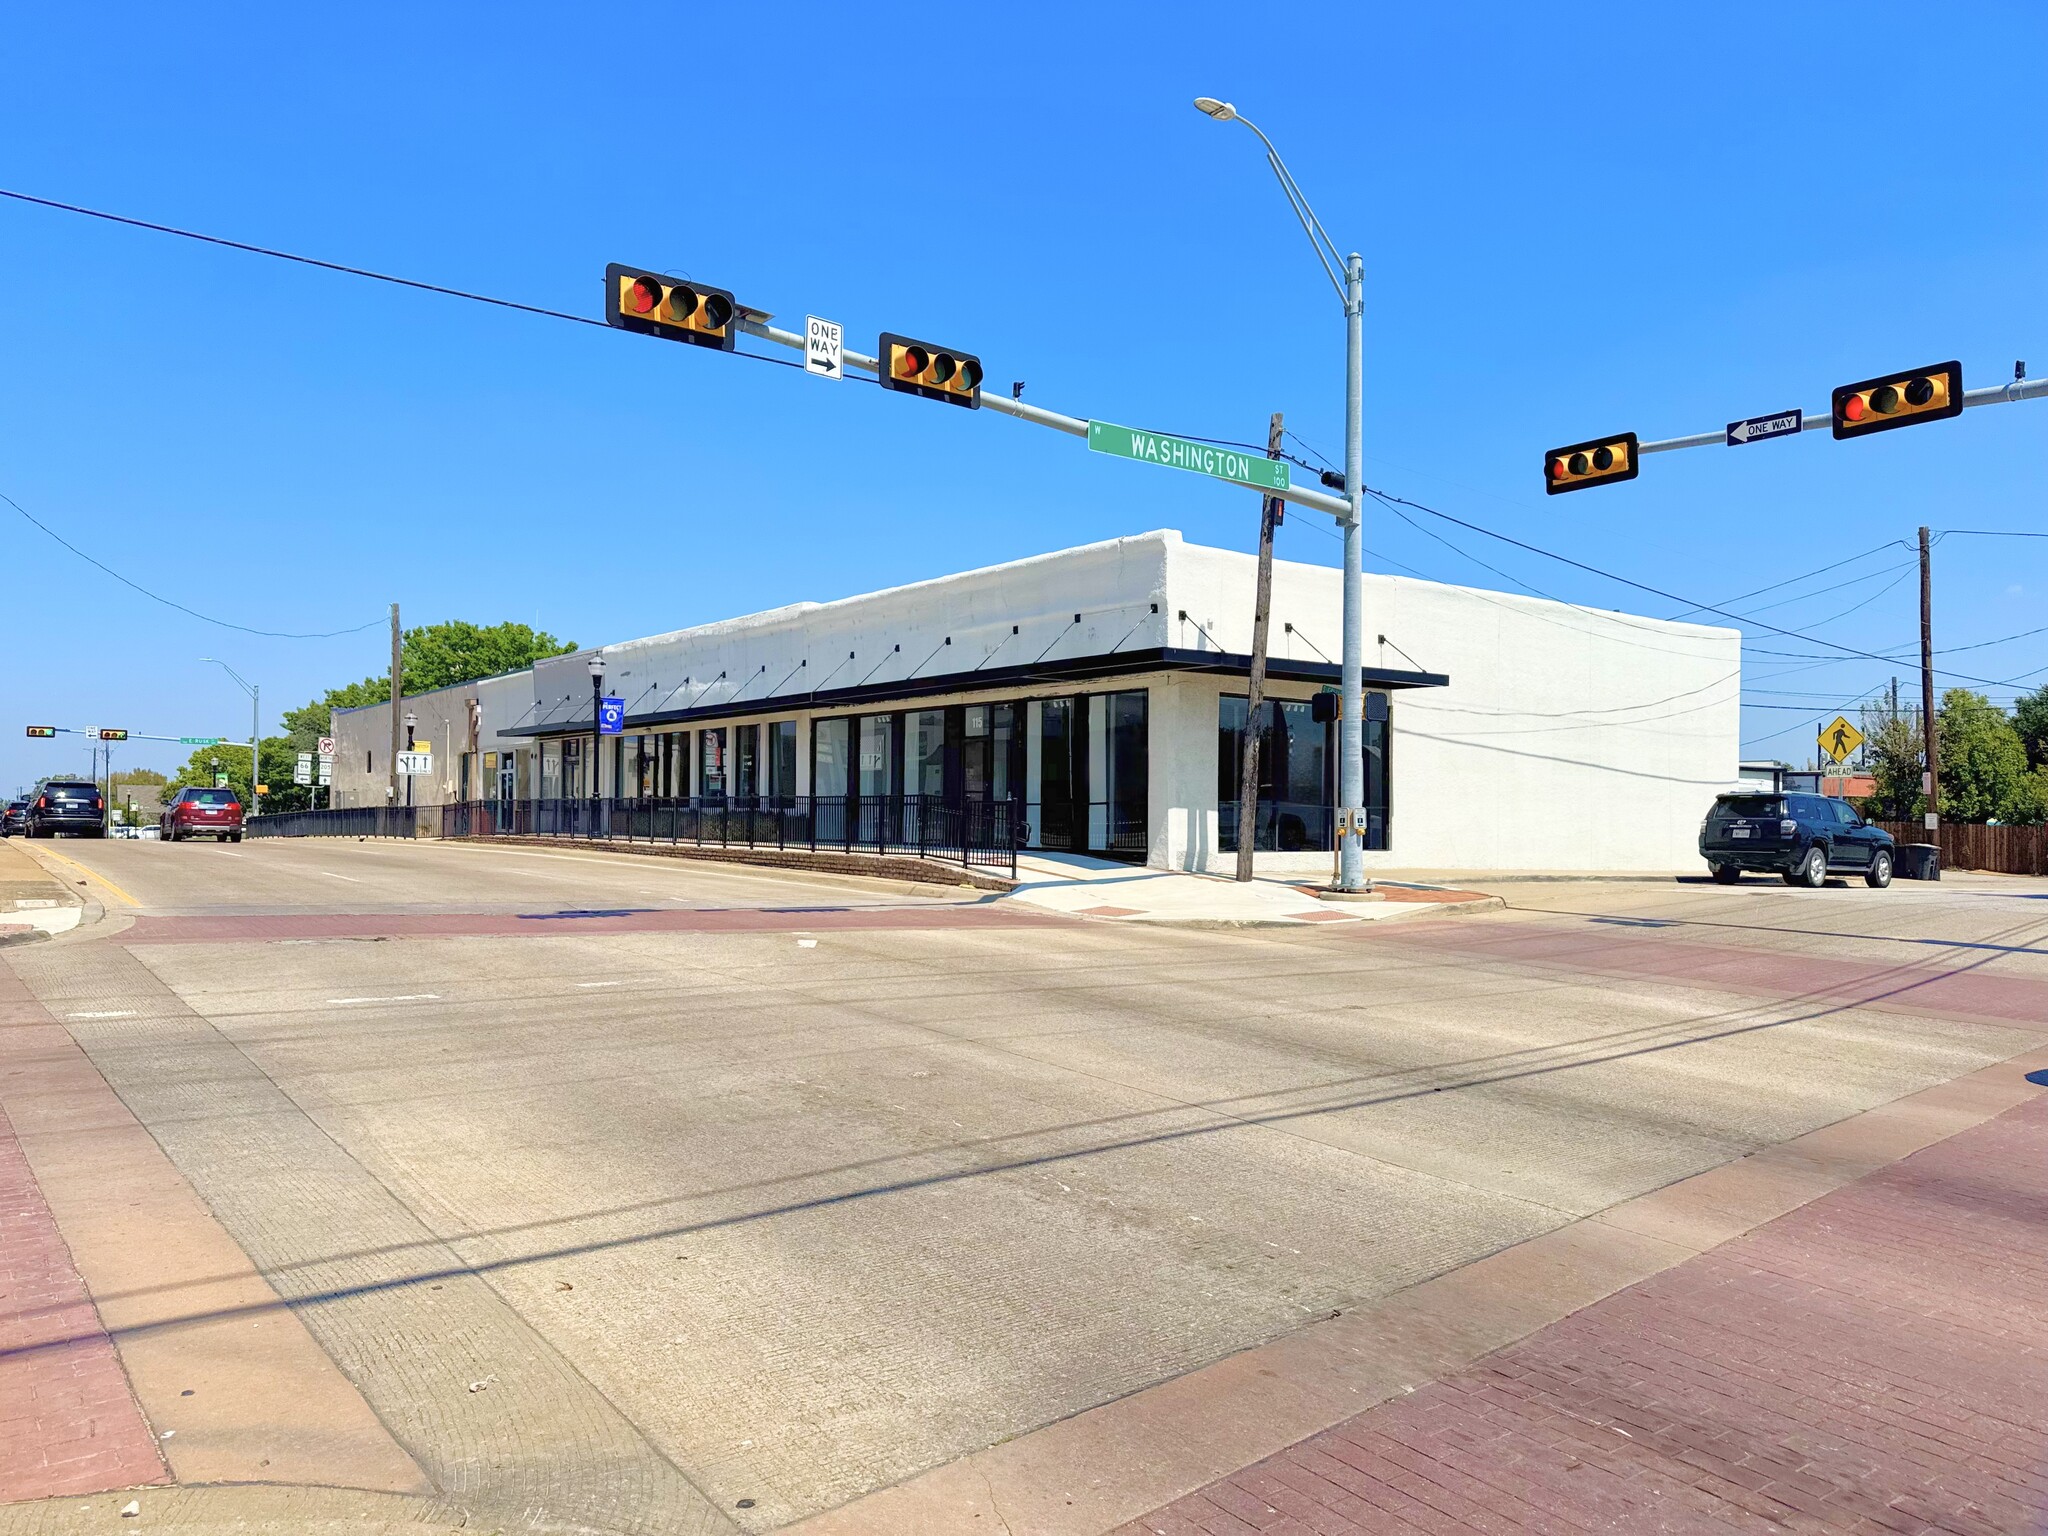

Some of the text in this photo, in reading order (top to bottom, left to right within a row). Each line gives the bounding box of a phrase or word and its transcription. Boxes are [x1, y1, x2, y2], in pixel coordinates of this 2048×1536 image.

[811, 322, 838, 341] ONE
[810, 337, 839, 356] WAY
[1748, 417, 1794, 435] ONE WAY
[1094, 424, 1283, 480] W WASHINGTON ST
[1273, 476, 1286, 488] 100
[972, 716, 983, 729] 115
[1827, 767, 1852, 776] AHEAD
